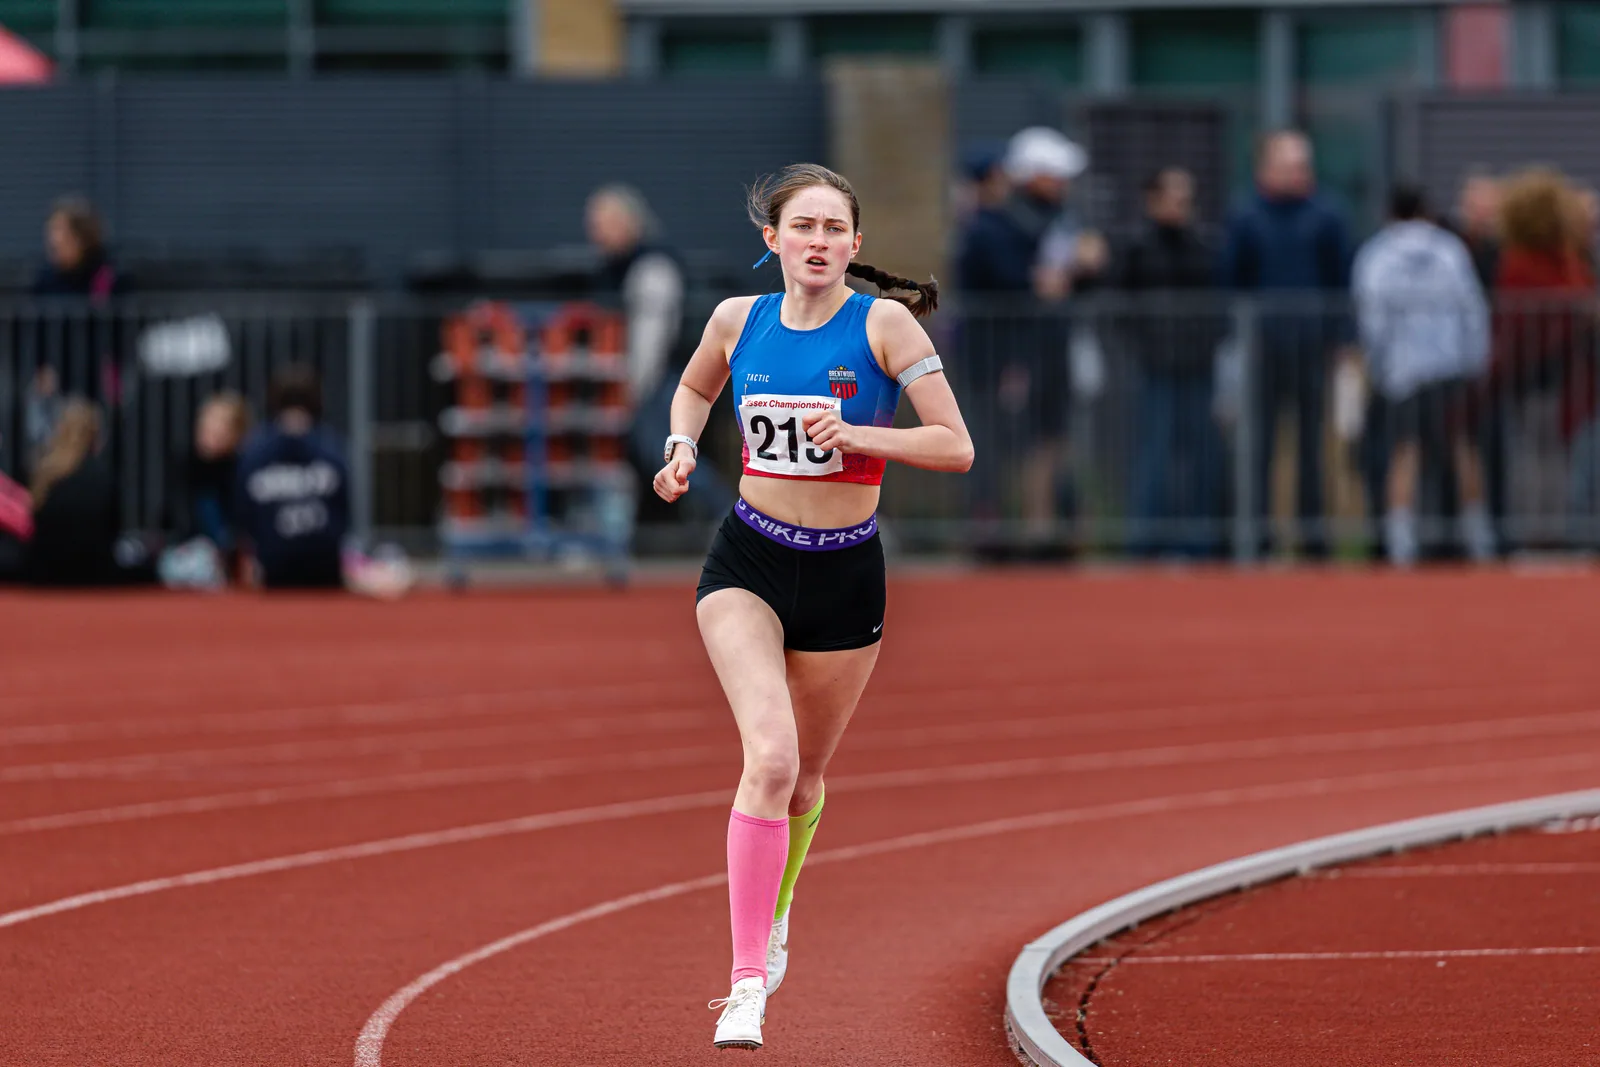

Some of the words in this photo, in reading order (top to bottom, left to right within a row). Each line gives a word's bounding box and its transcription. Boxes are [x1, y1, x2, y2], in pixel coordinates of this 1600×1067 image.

[746, 373, 770, 383] TACTIC
[768, 399, 835, 411] Championships
[748, 512, 812, 546] NIKE
